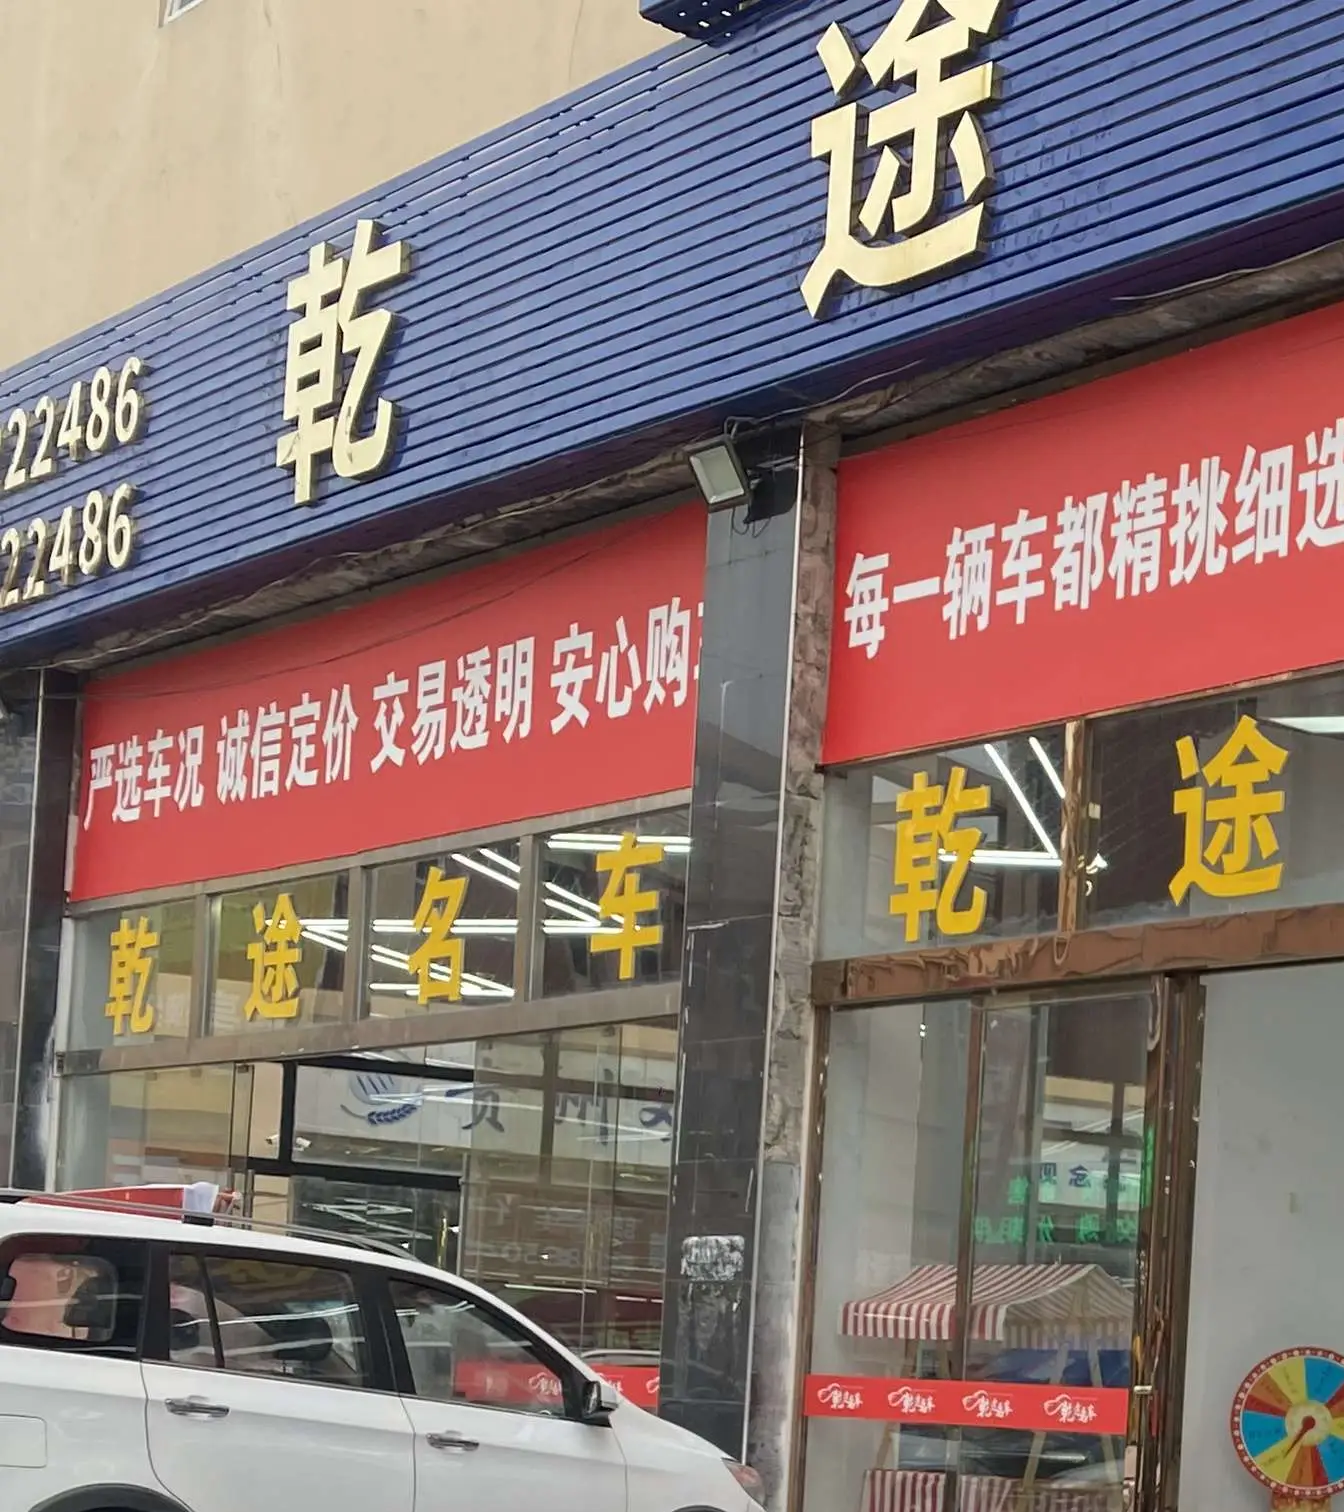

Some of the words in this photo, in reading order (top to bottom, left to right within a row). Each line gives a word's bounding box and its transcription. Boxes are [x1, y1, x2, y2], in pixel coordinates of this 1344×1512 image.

[277, 219, 411, 504] 乾
[800, 0, 1004, 320] 途
[4, 356, 148, 490] 22486
[0, 482, 138, 608] 22486
[83, 722, 205, 831] 严选车况
[215, 683, 360, 804] 诚信定价
[370, 635, 536, 773] 交易透明
[549, 596, 704, 736] 安心购
